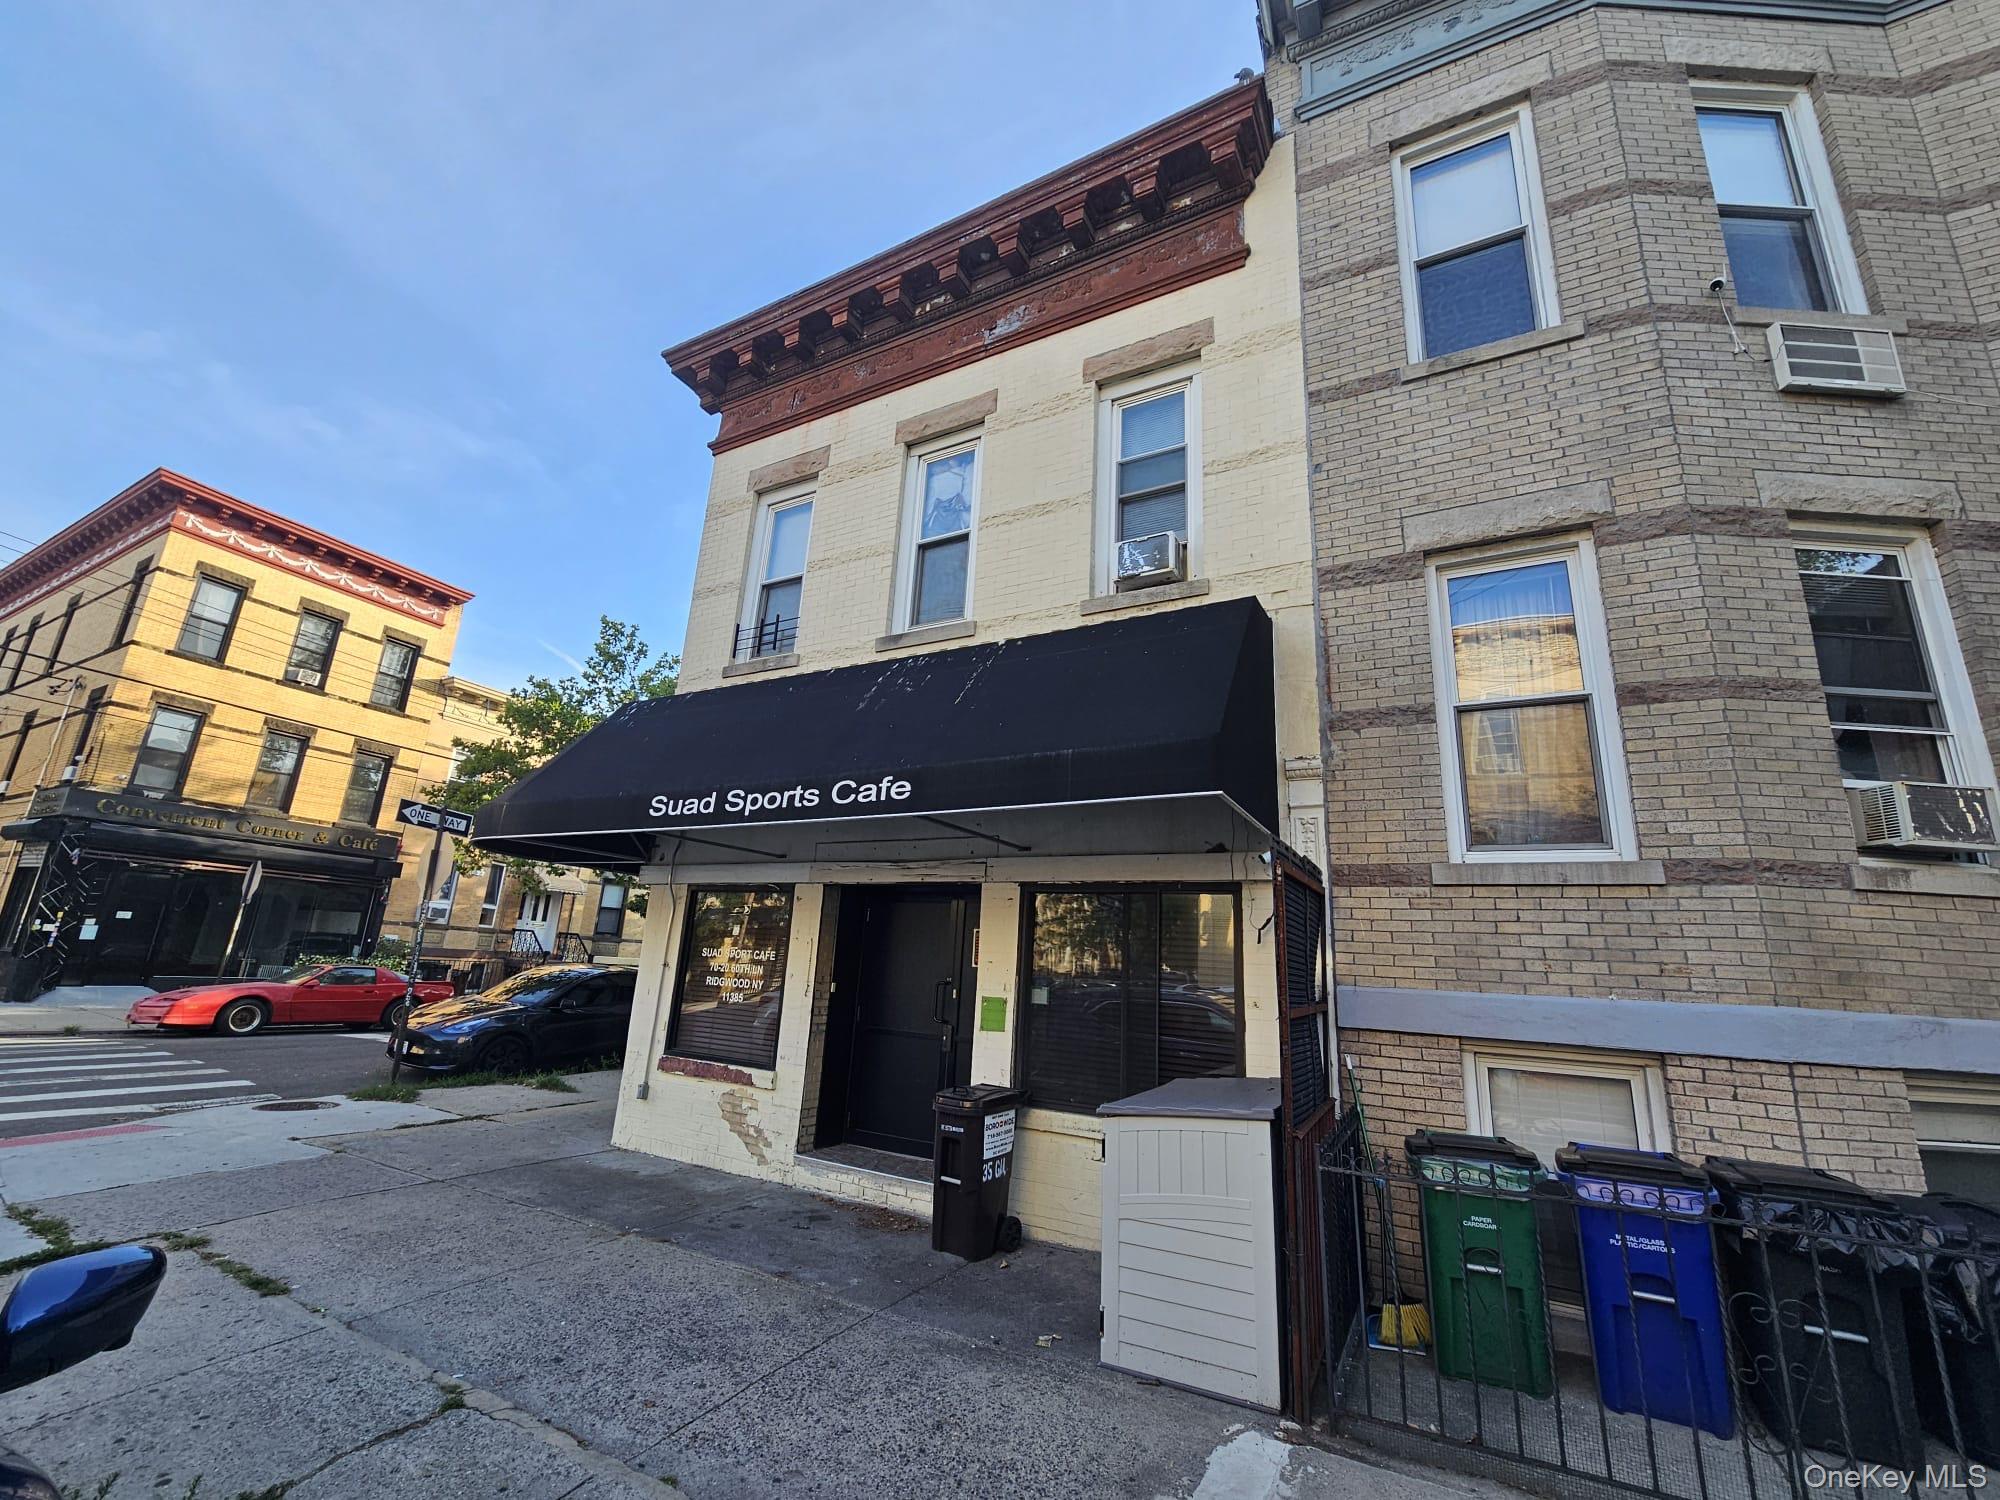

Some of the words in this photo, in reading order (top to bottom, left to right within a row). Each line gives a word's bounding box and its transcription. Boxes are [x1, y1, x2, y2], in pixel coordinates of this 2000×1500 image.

[649, 791, 716, 817] Suad
[724, 785, 820, 816] Sports
[831, 775, 912, 805] Cafe
[409, 808, 432, 822] ONE
[236, 819, 304, 841] Corner
[312, 831, 329, 844] &
[338, 833, 378, 851] Café
[701, 947, 723, 958] SUAD
[753, 950, 776, 961] CAFE
[710, 962, 730, 973] 70-20
[731, 964, 751, 974] 60TH
[705, 976, 751, 989] RIDGWOOD
[751, 980, 765, 992] NY
[722, 991, 744, 1003] 11385
[982, 1161, 993, 1183] 35
[1462, 1220, 1501, 1230] CARDBOAR
[1470, 1215, 1493, 1224] PAPER
